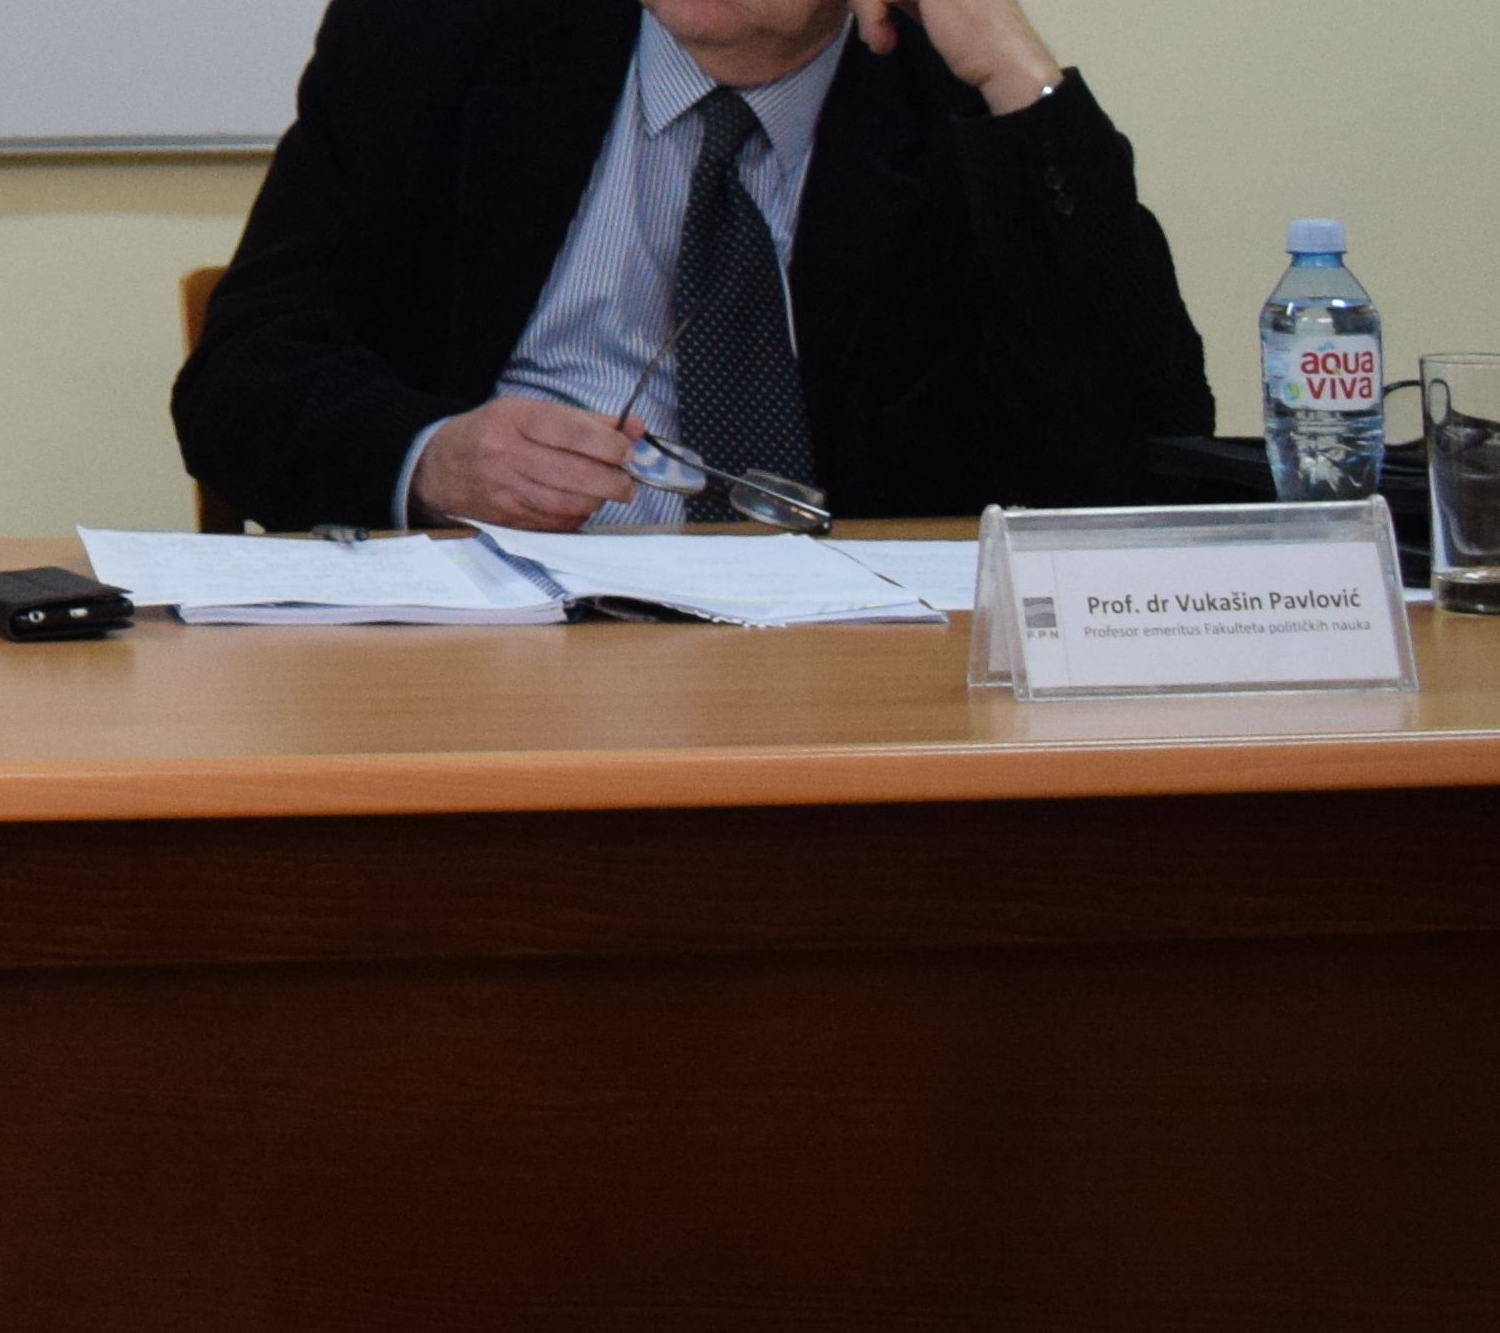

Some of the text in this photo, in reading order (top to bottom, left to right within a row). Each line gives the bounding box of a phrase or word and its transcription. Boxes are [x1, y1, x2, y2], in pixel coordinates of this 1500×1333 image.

[1300, 350, 1374, 375] aqua
[1306, 377, 1373, 400] viva
[1087, 587, 1361, 614] Prof. dr Vukašin Pavlović
[1084, 618, 1372, 639] Profesor emeritus Fakulteta političkih nauka
